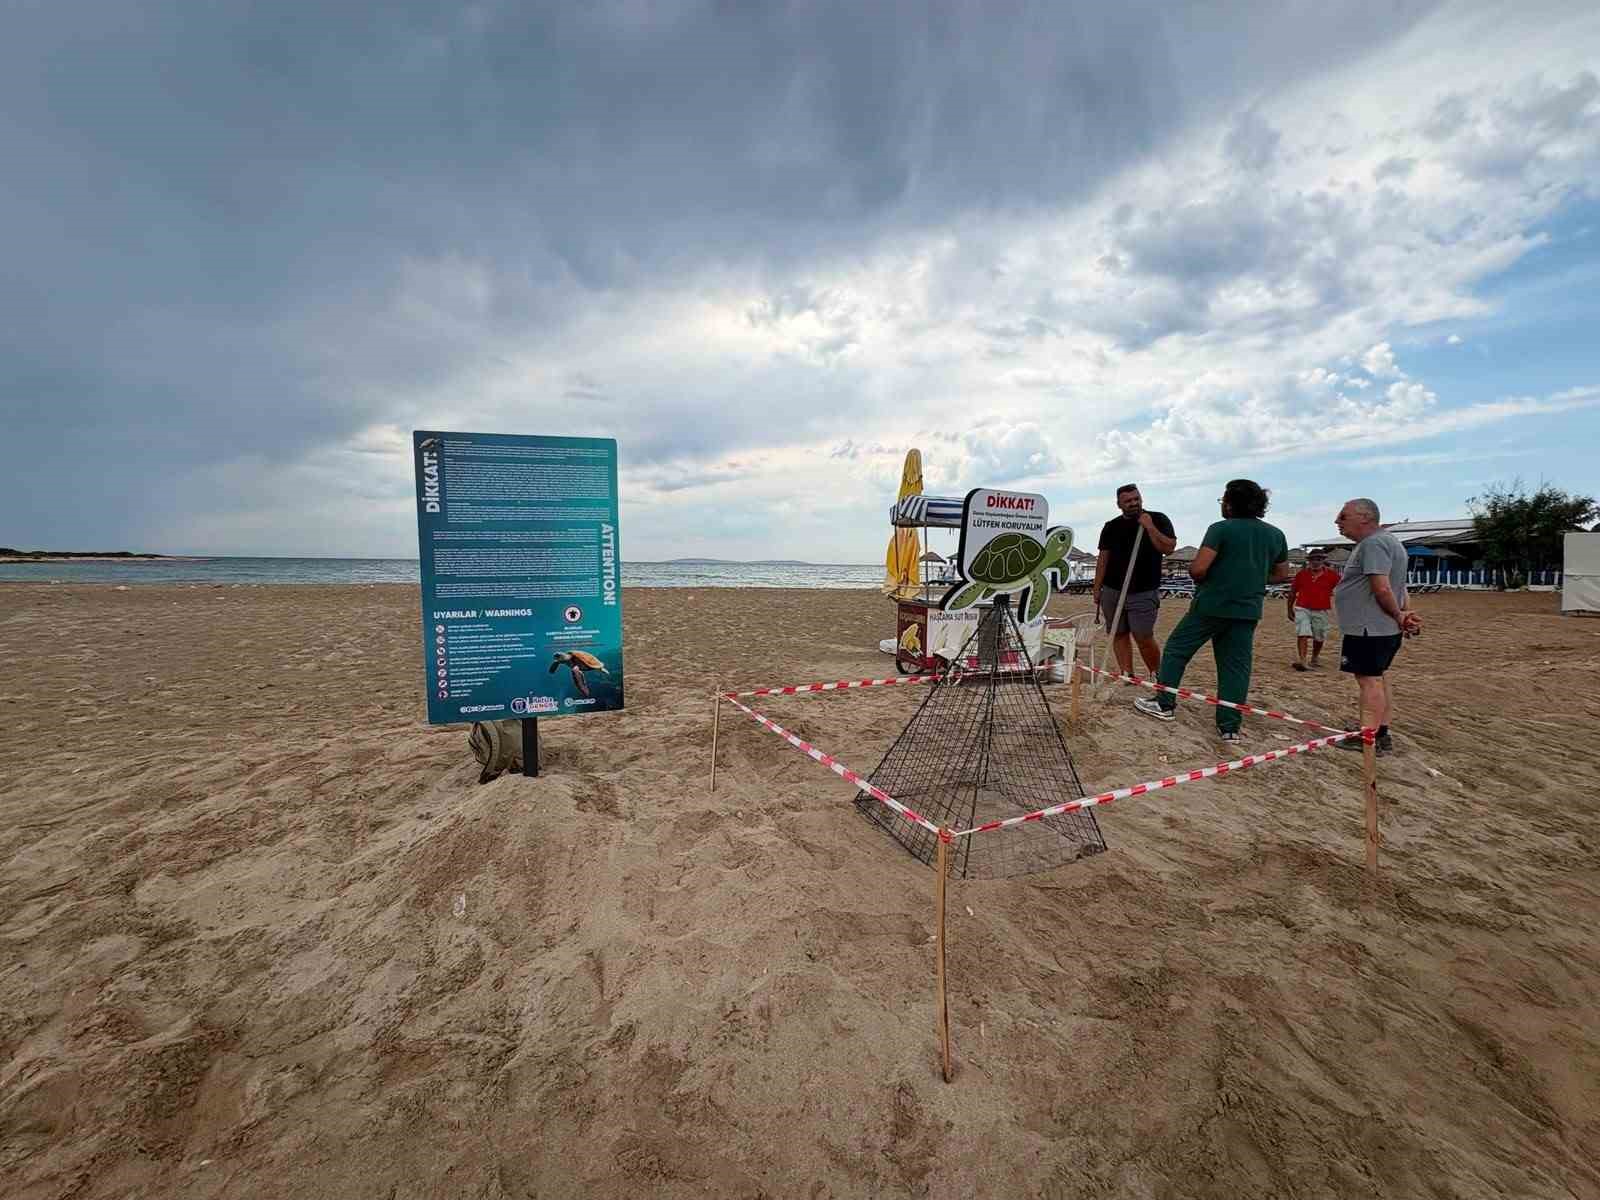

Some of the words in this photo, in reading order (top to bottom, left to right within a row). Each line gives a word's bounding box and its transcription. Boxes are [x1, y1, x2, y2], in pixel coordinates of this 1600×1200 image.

[421, 452, 440, 513] DİKKAT!
[986, 492, 1035, 511] DİKKAT!
[972, 519, 1000, 529] LÜTFEN
[1000, 521, 1043, 531] KORUYALIM
[601, 523, 616, 606] ATTENTION!
[433, 611, 477, 619] UYARILAR
[484, 608, 533, 617] WARNINGS
